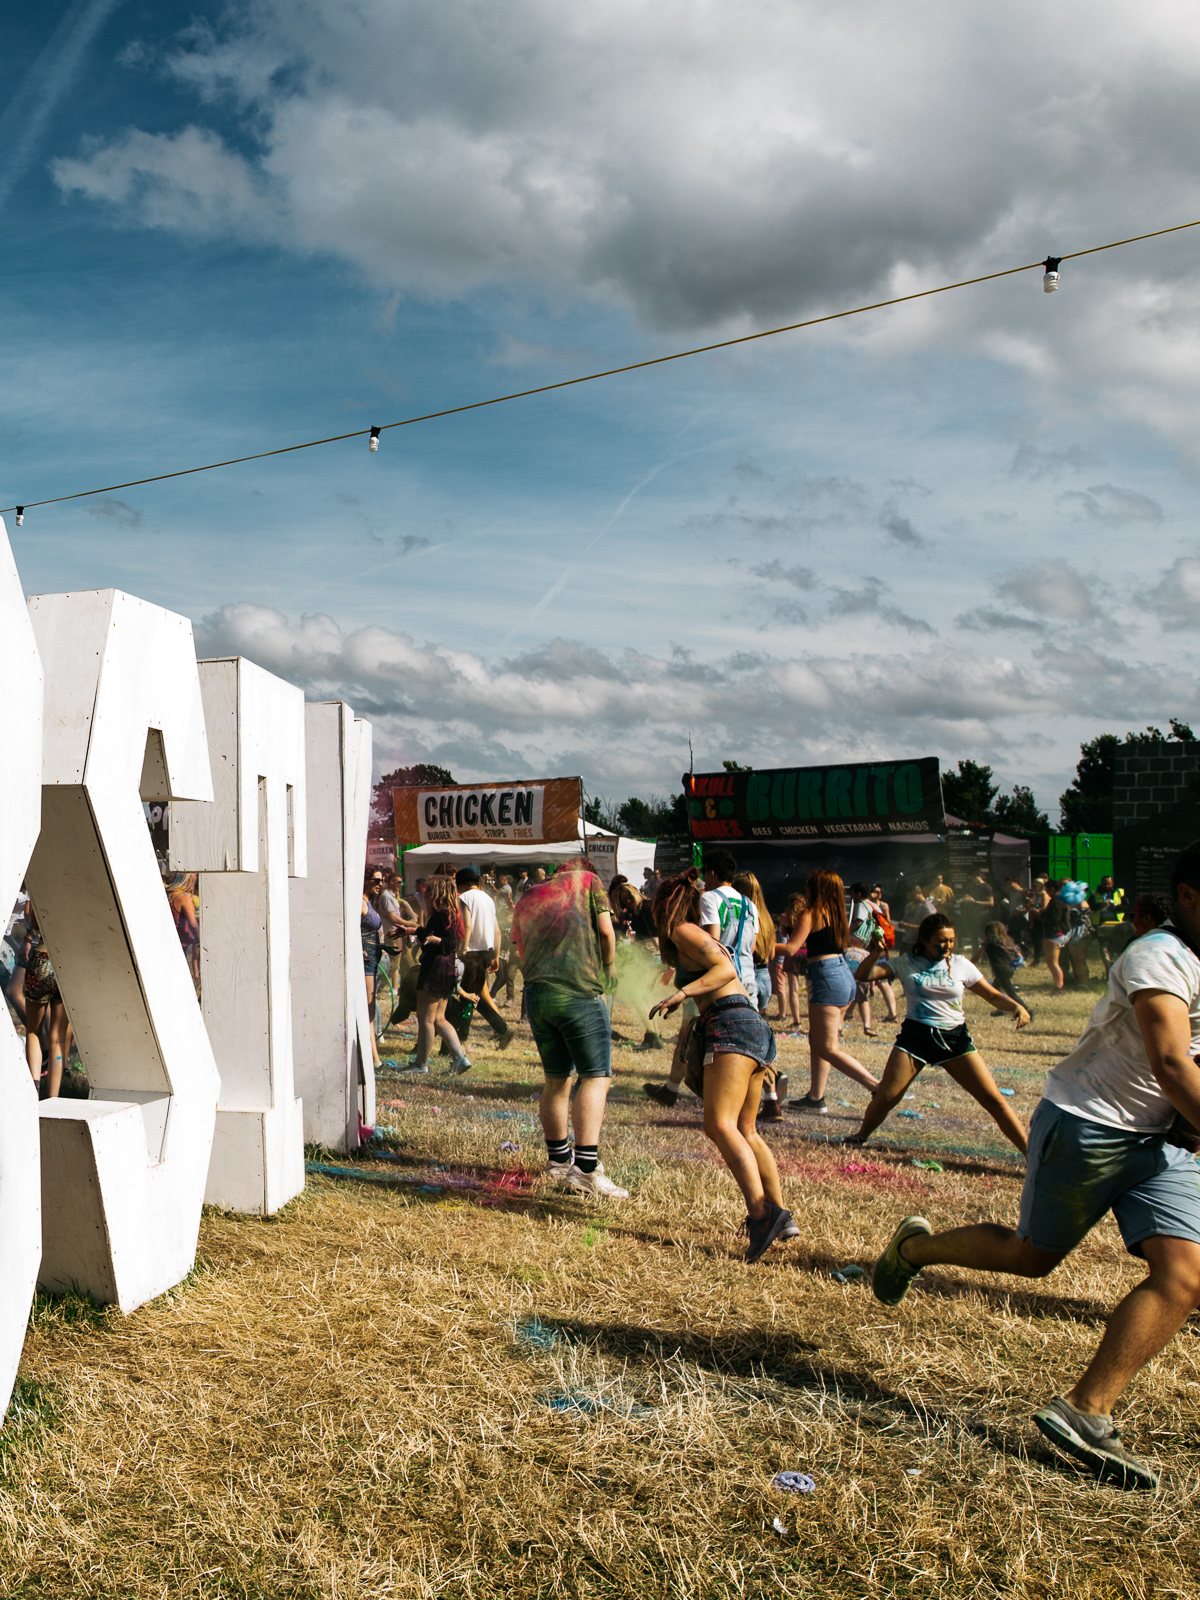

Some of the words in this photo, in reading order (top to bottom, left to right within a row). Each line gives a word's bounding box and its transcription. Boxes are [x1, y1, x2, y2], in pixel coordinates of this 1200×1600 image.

[746, 763, 924, 822] BURRITO
[424, 790, 534, 828] CHICKEN
[426, 830, 452, 841] BURGER
[456, 829, 480, 839] WINGS
[484, 828, 507, 838] STRIPS
[513, 828, 534, 838] FRIES
[691, 819, 744, 839] BONES
[751, 826, 773, 836] BEEF
[778, 825, 819, 836] CHICKEN
[823, 822, 883, 834] VEGETARIAN
[887, 820, 930, 832] NACHOS
[368, 846, 394, 856] CHICKEN
[588, 844, 615, 853] CHICKEN
